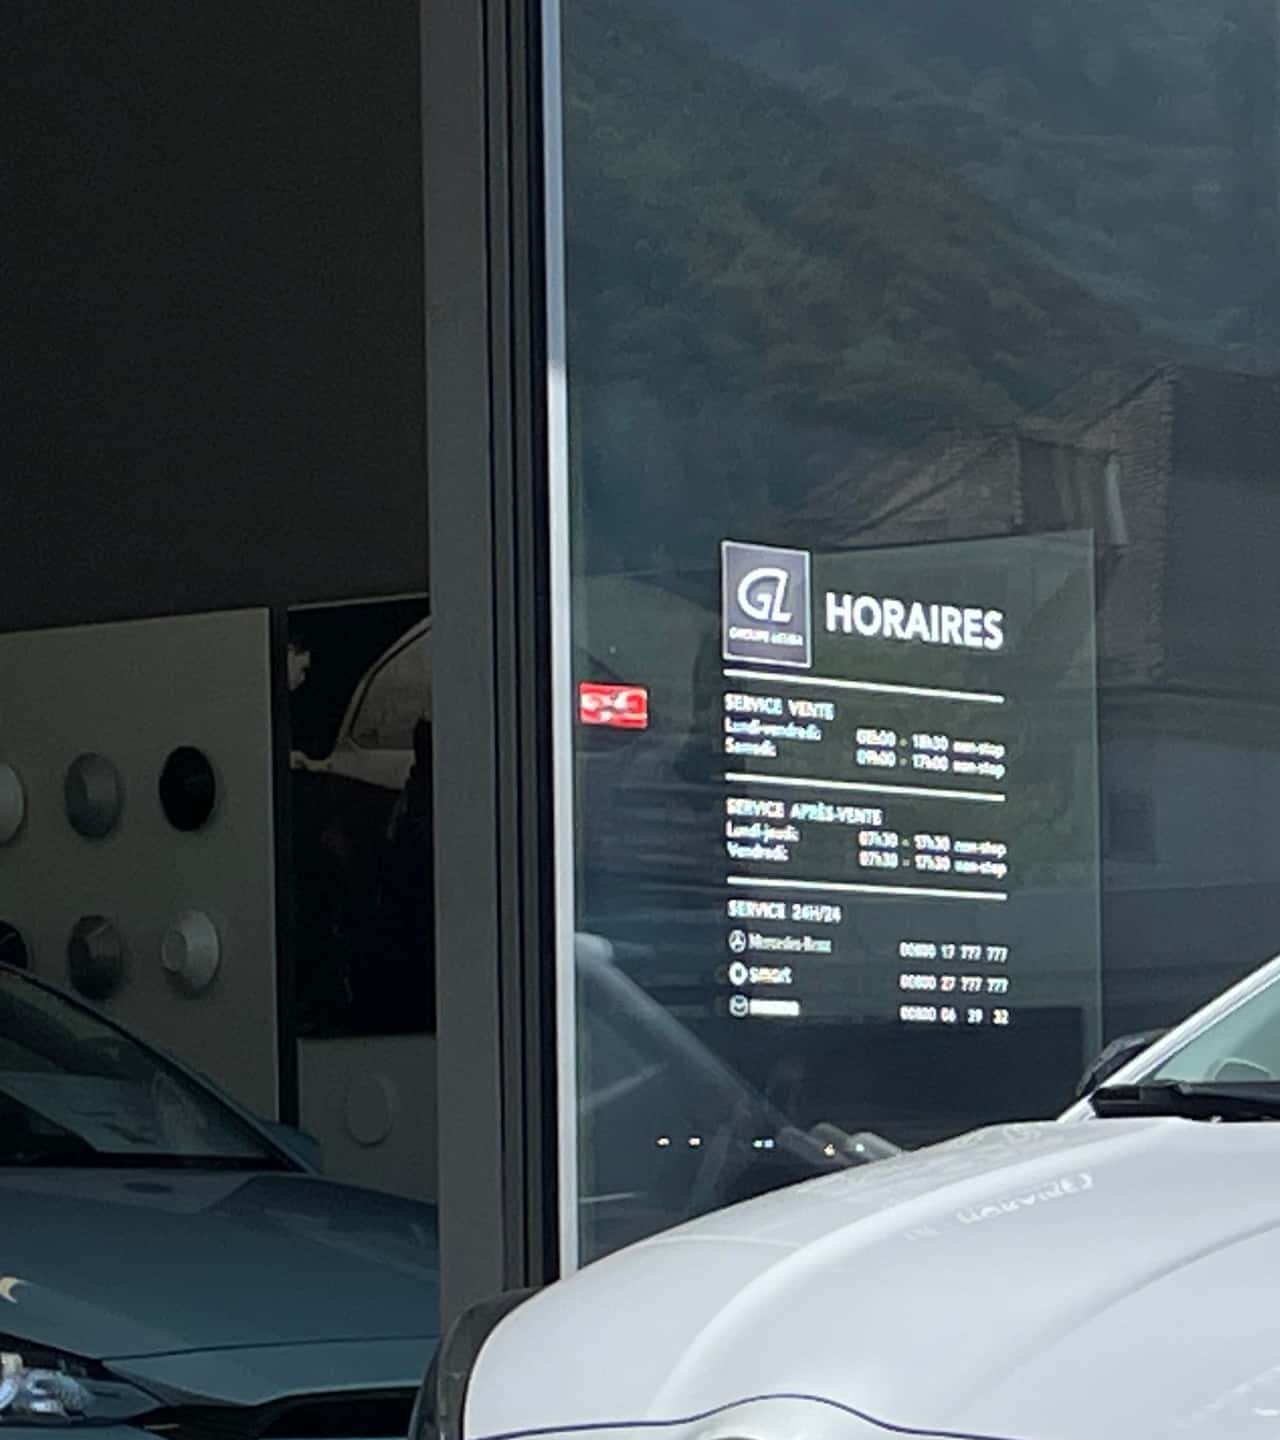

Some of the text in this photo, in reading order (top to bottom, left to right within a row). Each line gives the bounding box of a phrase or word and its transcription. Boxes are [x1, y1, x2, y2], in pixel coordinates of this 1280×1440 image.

[825, 591, 1004, 651] HORAIRES
[725, 694, 834, 720] SERVICE VENTE
[727, 798, 785, 818] SERVICE
[728, 899, 786, 919] SERVICE
